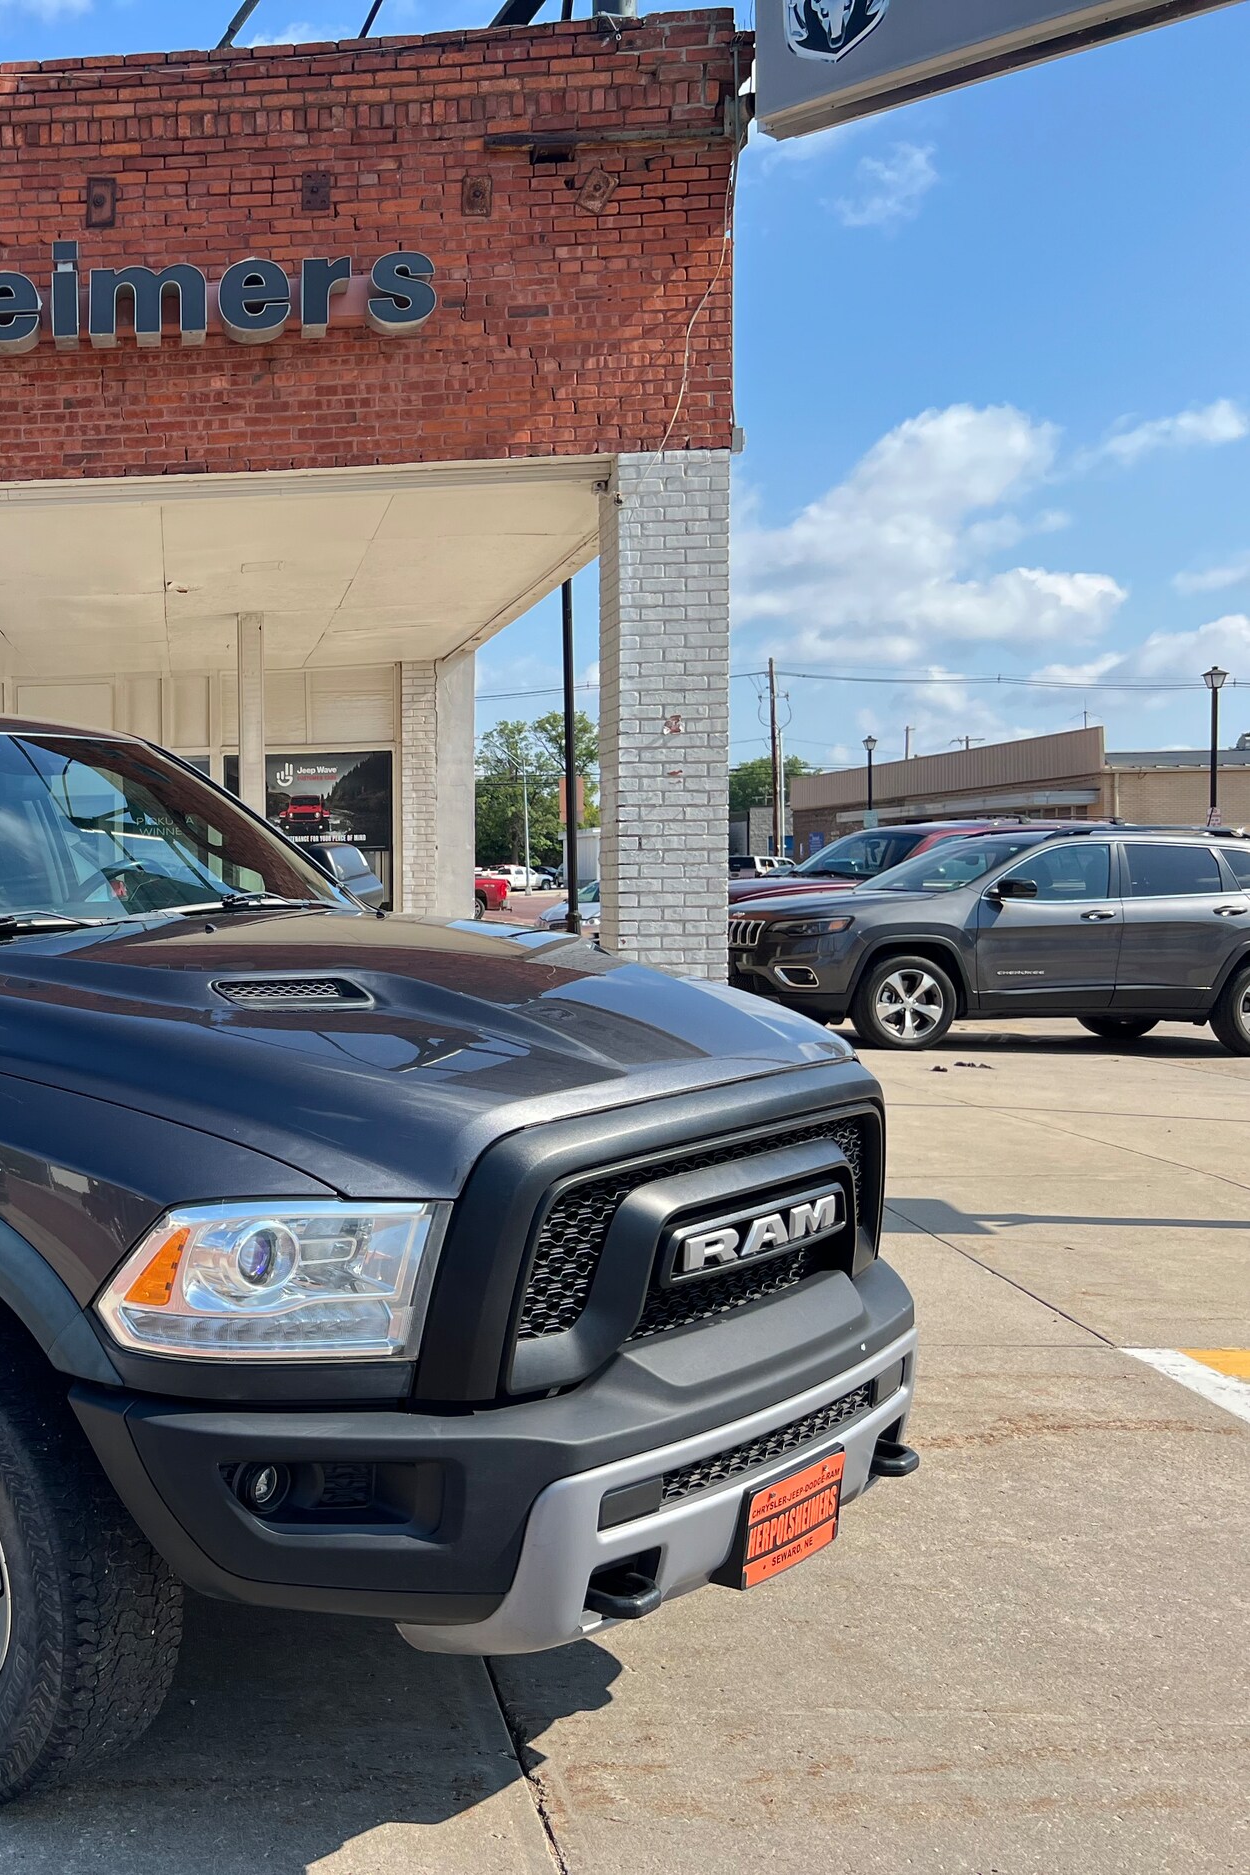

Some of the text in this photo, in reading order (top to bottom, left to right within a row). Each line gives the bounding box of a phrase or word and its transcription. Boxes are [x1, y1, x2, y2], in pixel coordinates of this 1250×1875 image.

[296, 766, 338, 775] Jeep Wave
[139, 827, 183, 836] WINNE
[683, 1194, 837, 1273] RAM
[747, 1484, 838, 1560] HERPOLSHEIMERS
[771, 1536, 814, 1567] SEWARD, NE
